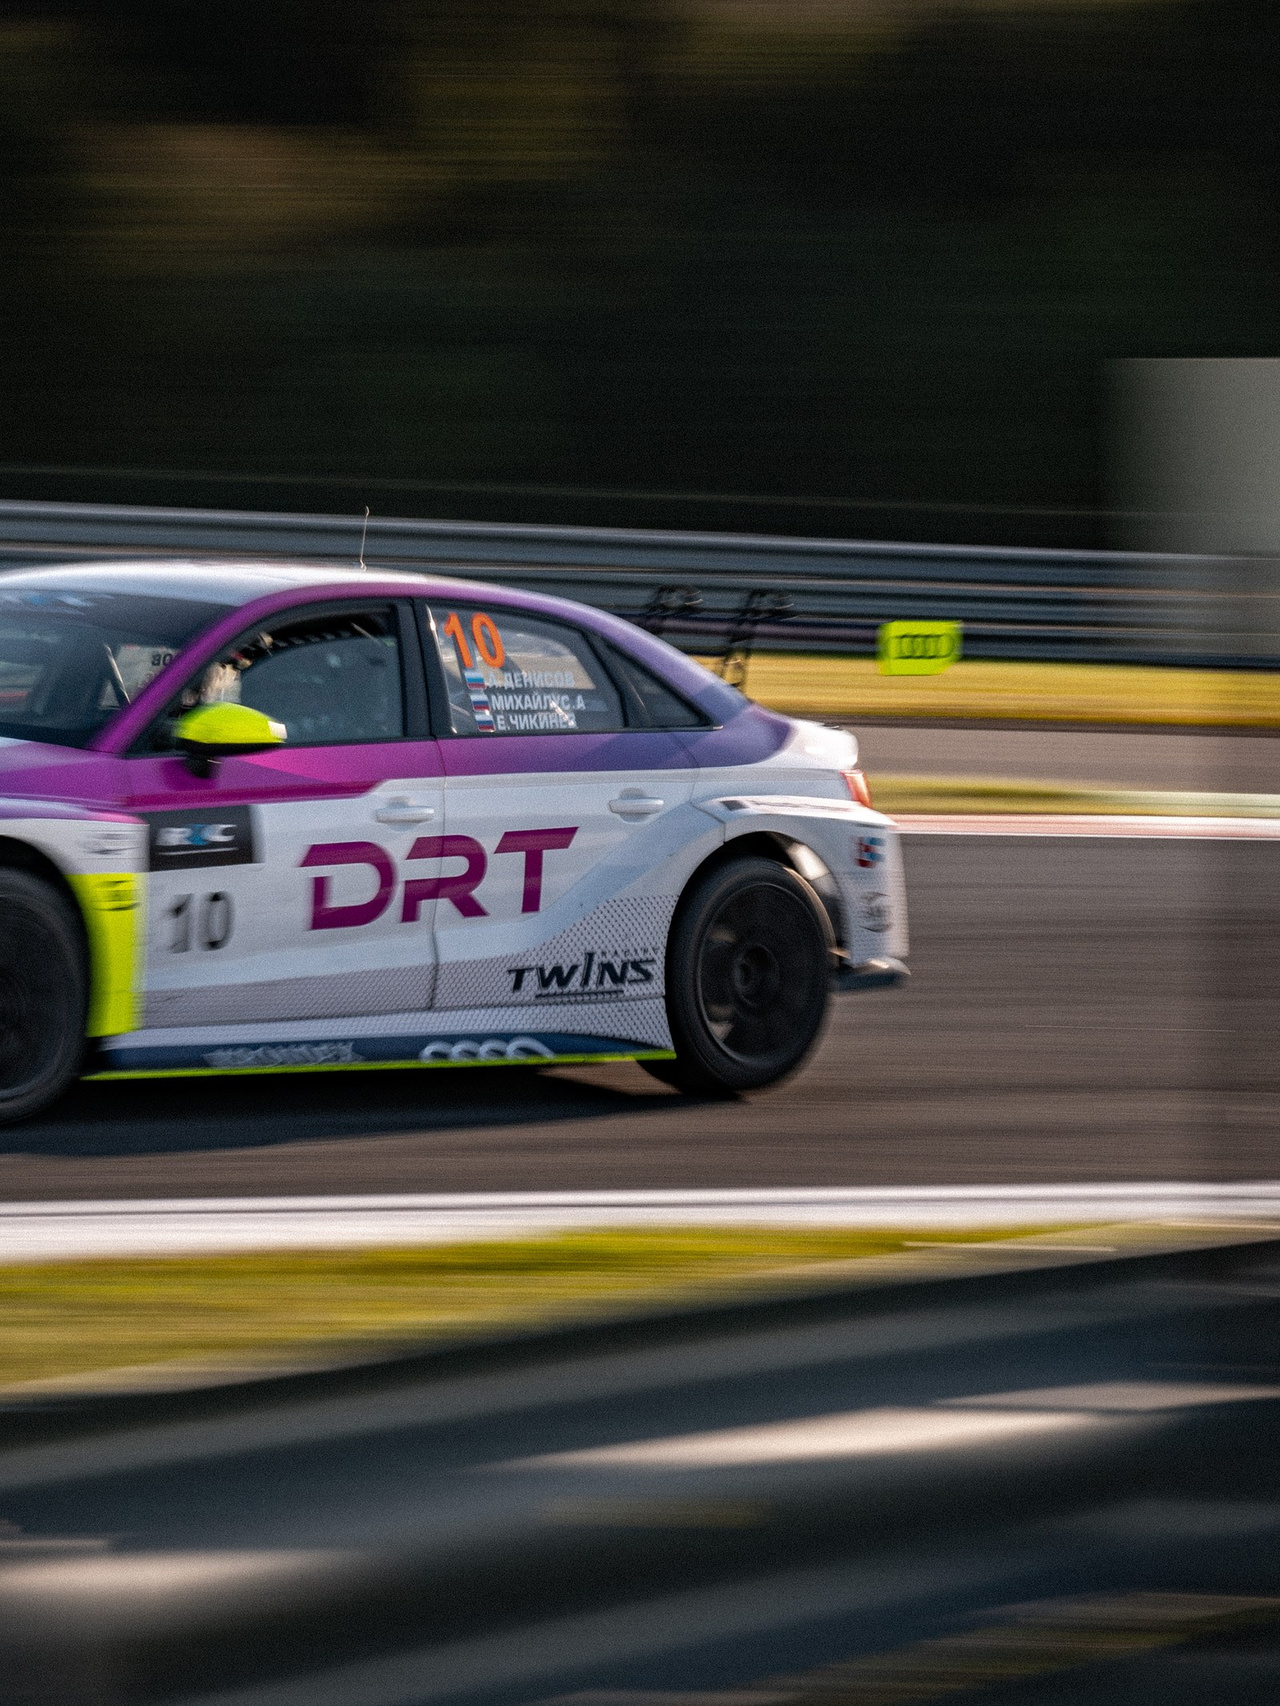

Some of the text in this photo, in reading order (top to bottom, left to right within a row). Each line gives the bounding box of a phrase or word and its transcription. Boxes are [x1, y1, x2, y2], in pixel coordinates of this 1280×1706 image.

[443, 611, 505, 668] 10
[299, 826, 579, 931] DRT
[166, 890, 235, 954] 10
[507, 951, 657, 993] TWINS
